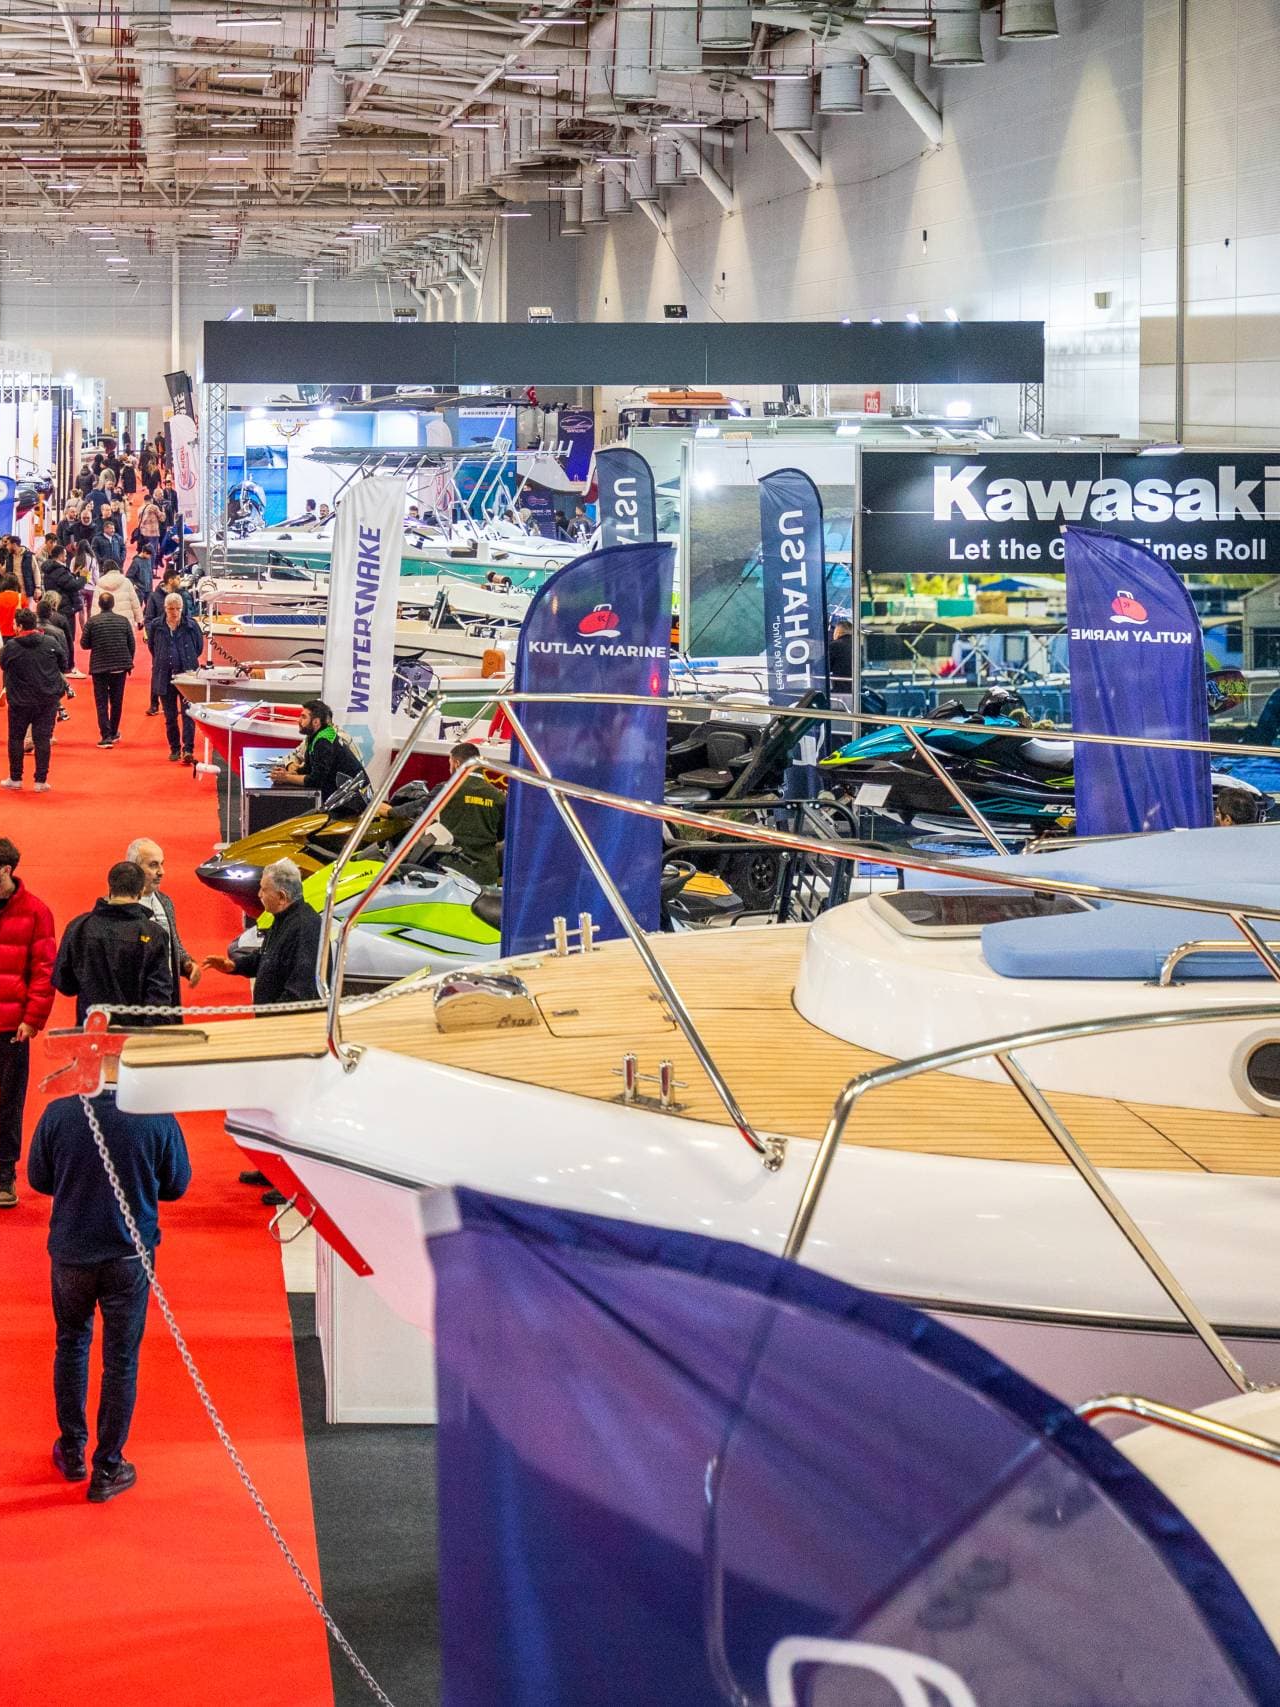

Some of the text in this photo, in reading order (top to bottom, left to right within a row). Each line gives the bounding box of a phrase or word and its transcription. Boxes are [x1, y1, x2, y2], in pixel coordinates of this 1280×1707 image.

[933, 465, 1280, 523] Kawasaki
[949, 538, 990, 560] Let
[999, 538, 1042, 560] the
[1215, 538, 1266, 560] Roll
[346, 525, 381, 713] WATERSNAKE
[528, 641, 667, 658] KUTLAY MARINE
